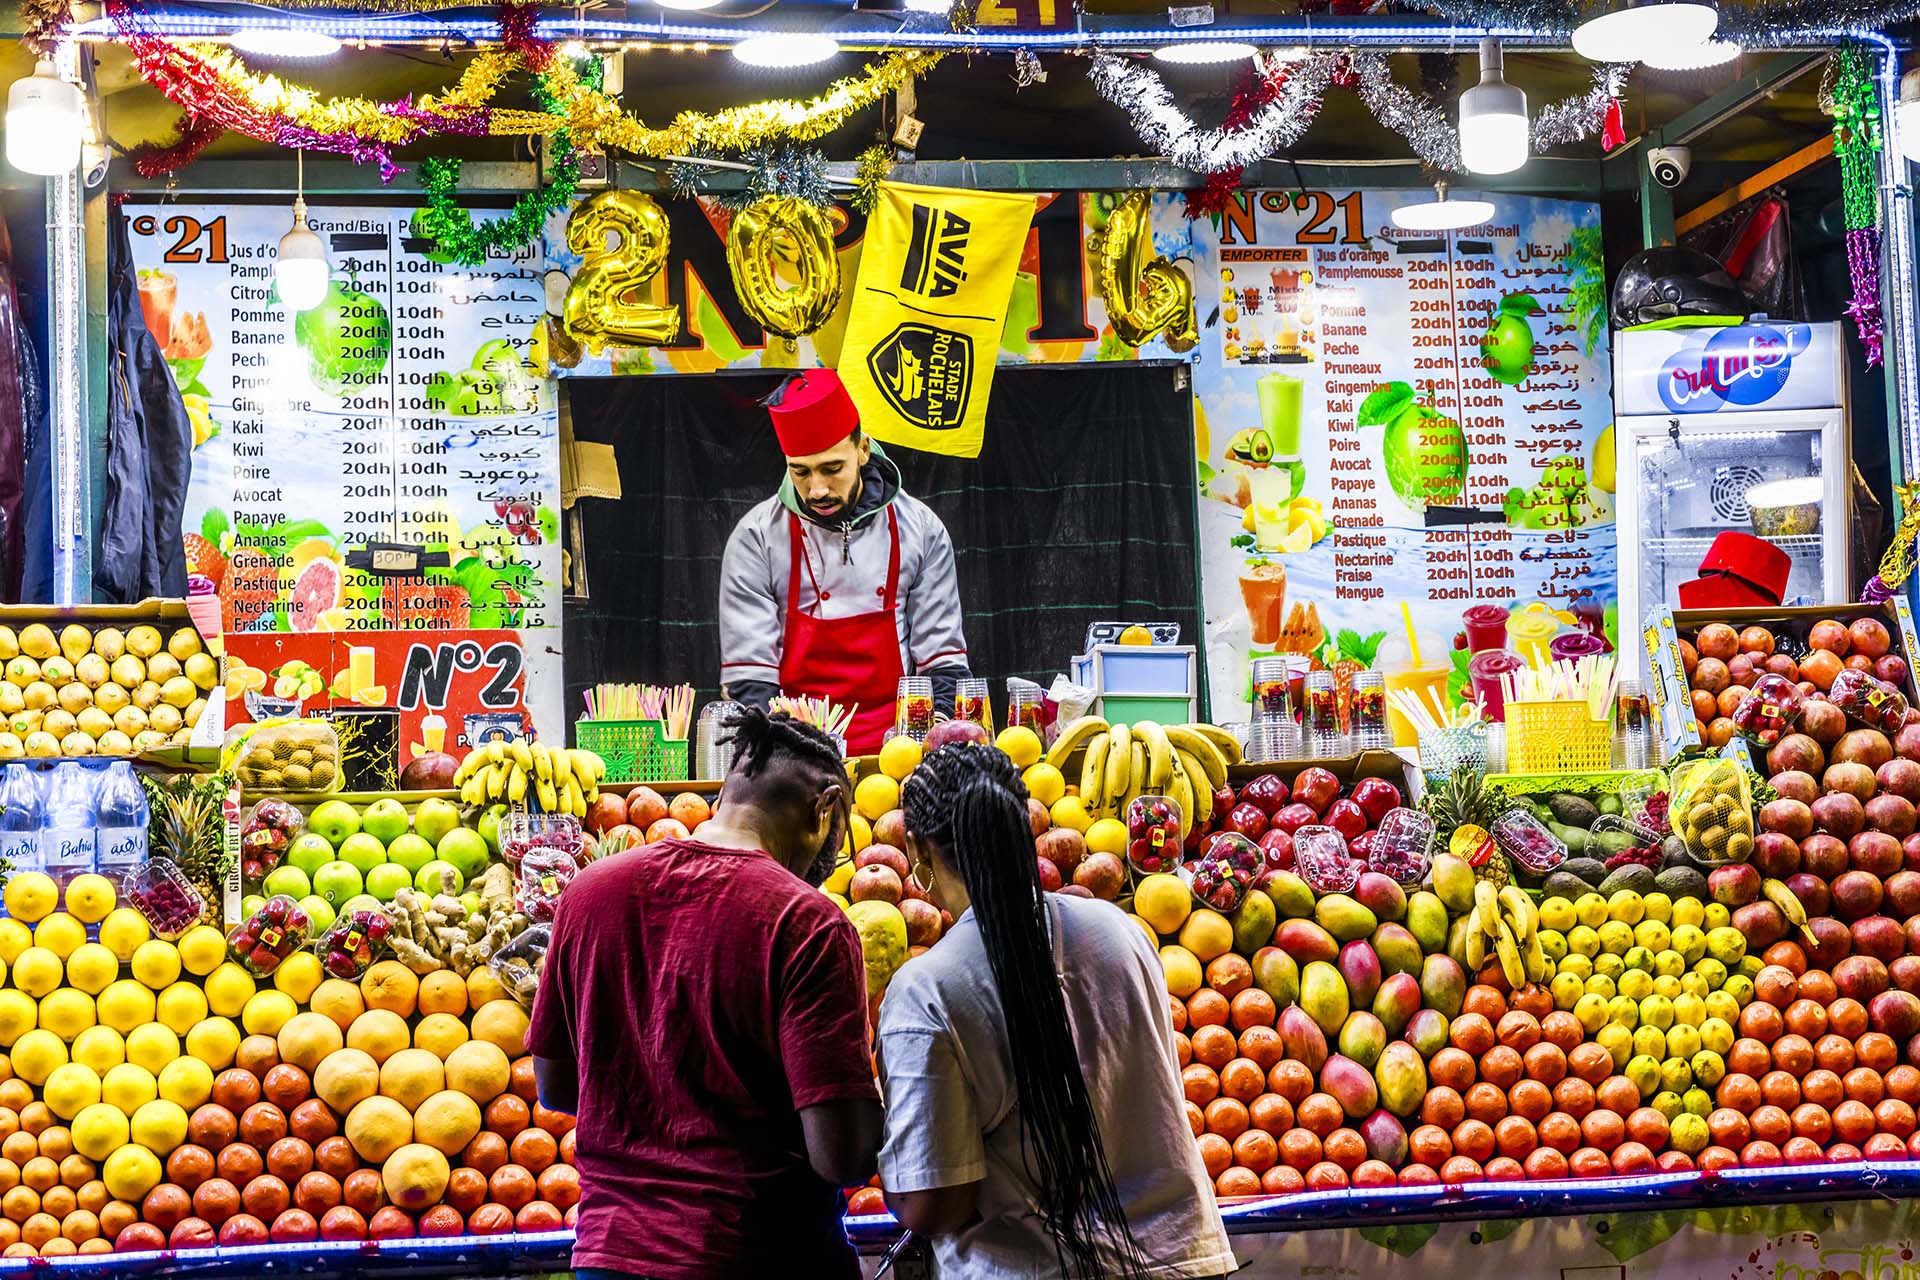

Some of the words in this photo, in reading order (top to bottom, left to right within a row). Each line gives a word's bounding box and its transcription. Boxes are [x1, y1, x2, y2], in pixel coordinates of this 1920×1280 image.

[307, 219, 385, 234] Grand/Big
[1455, 223, 1520, 238] Petit/Small
[121, 215, 230, 264] °21
[230, 244, 252, 259] Jus
[1220, 249, 1302, 261] EMPORTER
[1317, 249, 1336, 262] Jus
[340, 260, 386, 272] 20dh
[396, 260, 442, 273] 10dh
[1318, 266, 1403, 281] Pamplemousse
[1408, 260, 1447, 272] 20dh
[1455, 260, 1494, 271] 10dh
[231, 286, 274, 300] Citron
[340, 281, 387, 293] 20dh
[1409, 278, 1448, 290] 20dh
[1456, 278, 1496, 289] 10dh
[232, 308, 285, 323] Pomme
[340, 306, 387, 318] 20dh
[397, 307, 443, 319] 10dh
[1321, 304, 1366, 316] Pomme
[1410, 300, 1450, 312] 20dh
[1457, 300, 1496, 311] 10dh
[1322, 324, 1367, 336] Banane
[1411, 318, 1451, 329] 20dh
[1458, 317, 1498, 329] 10dh
[232, 330, 285, 345] Banane
[341, 326, 387, 338] 20dh
[397, 327, 444, 339] 10dh
[1323, 343, 1359, 355] Peche
[1412, 335, 1452, 347] 20dh
[1460, 335, 1499, 346] 10dh
[341, 347, 388, 359] 20dh
[398, 347, 444, 360] 10dh
[1324, 362, 1382, 374] Pruneaux
[1414, 358, 1454, 369] 20dh
[1461, 357, 1500, 368] 10dh
[341, 372, 388, 384] 20dh
[398, 373, 445, 385] 10dh
[926, 332, 952, 427] ROCHELAIS
[945, 360, 962, 402] STADE
[1325, 381, 1391, 395] Gingembre
[1416, 379, 1455, 390] 20dh
[1462, 379, 1502, 390] 10dh
[342, 397, 389, 409] 20dh
[398, 398, 445, 410] 10dh
[1327, 400, 1353, 413] Kaki
[1416, 396, 1456, 408] 20dh
[1464, 396, 1503, 407] 10dh
[233, 420, 263, 434] Kaki
[1328, 419, 1354, 432] Kiwi
[1418, 418, 1457, 429] 20dh
[1465, 417, 1504, 428] 10dh
[233, 442, 263, 457] Kiwi
[1329, 439, 1360, 451] Poire
[1419, 435, 1458, 446] 20dh
[1466, 434, 1505, 445] 10dh
[1330, 458, 1371, 471] Avocat
[1421, 455, 1460, 466] 20dh
[1468, 454, 1507, 465] 10dh
[233, 465, 270, 479] Poire
[343, 463, 390, 474] 20dh
[400, 463, 447, 475] 10dh
[1331, 477, 1375, 493] Papaye
[1422, 477, 1462, 488] 20dh
[1469, 476, 1509, 488] 10dh
[233, 488, 282, 502] Avocat
[344, 486, 390, 497] 20dh
[400, 486, 447, 497] 10dh
[1332, 497, 1377, 510] Ananas
[1424, 494, 1463, 506] 20dh
[1470, 494, 1510, 505] 10dh
[234, 510, 286, 527] Papaye
[344, 512, 391, 524] 20dh
[401, 512, 448, 524] 10dh
[1332, 514, 1384, 528] Grenade
[234, 533, 286, 547] Ananas
[402, 532, 448, 544] 10dh
[1334, 534, 1386, 549] Pastique
[1425, 531, 1465, 543] 20dh
[1472, 531, 1512, 541] 10dh
[234, 554, 294, 568] Grenade
[1335, 553, 1393, 567] Nectarine
[1426, 551, 1466, 562] 20dh
[1474, 550, 1513, 561] 10dh
[1336, 569, 1372, 582] Fraise
[1428, 568, 1467, 580] 20dh
[1475, 568, 1514, 579] 10dh
[234, 576, 296, 593] Pastique
[345, 574, 392, 586] 20dh
[402, 575, 449, 586] 10dh
[1336, 586, 1384, 601] Mangue
[1428, 588, 1469, 599] 20dh
[1476, 587, 1516, 598] 10dh
[234, 600, 304, 614] Nectarine
[345, 598, 392, 609] 20dh
[403, 598, 449, 609] 10dh
[234, 617, 277, 631] Fraise
[346, 618, 393, 630] 20dh
[403, 618, 450, 630] 10dh
[229, 812, 240, 852] FRUITS
[61, 838, 92, 859] Bahia
